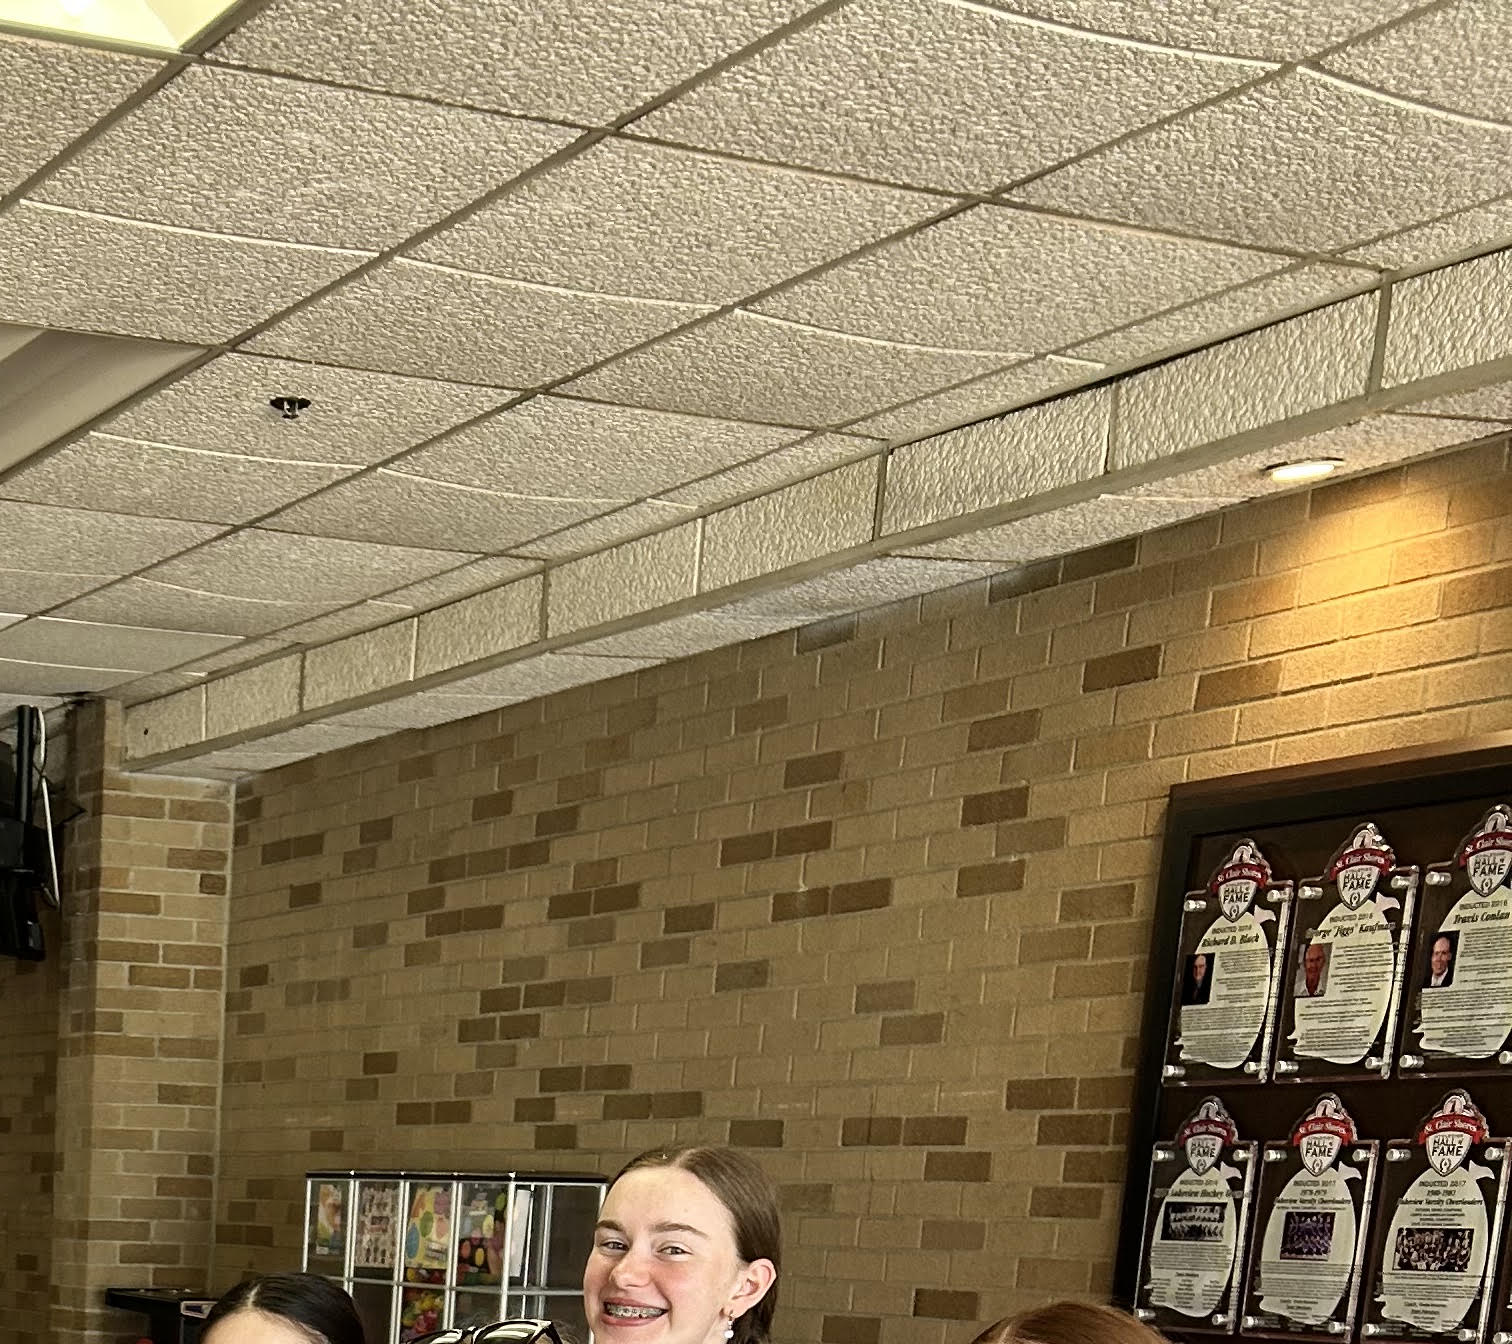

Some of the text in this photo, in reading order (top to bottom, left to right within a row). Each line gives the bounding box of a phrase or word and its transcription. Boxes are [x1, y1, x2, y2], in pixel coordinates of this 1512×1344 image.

[1474, 858, 1498, 866] HALL
[1472, 864, 1505, 876] FAME
[1343, 872, 1366, 880] HALL
[1343, 879, 1372, 889] FAME
[1224, 886, 1245, 894] HALL
[1223, 892, 1250, 904] FAME
[1306, 1140, 1327, 1148] HALL
[1433, 1138, 1456, 1146] HALL
[1191, 1147, 1216, 1158] FAME
[1305, 1147, 1333, 1157] FAME
[1431, 1145, 1464, 1156] FAME
